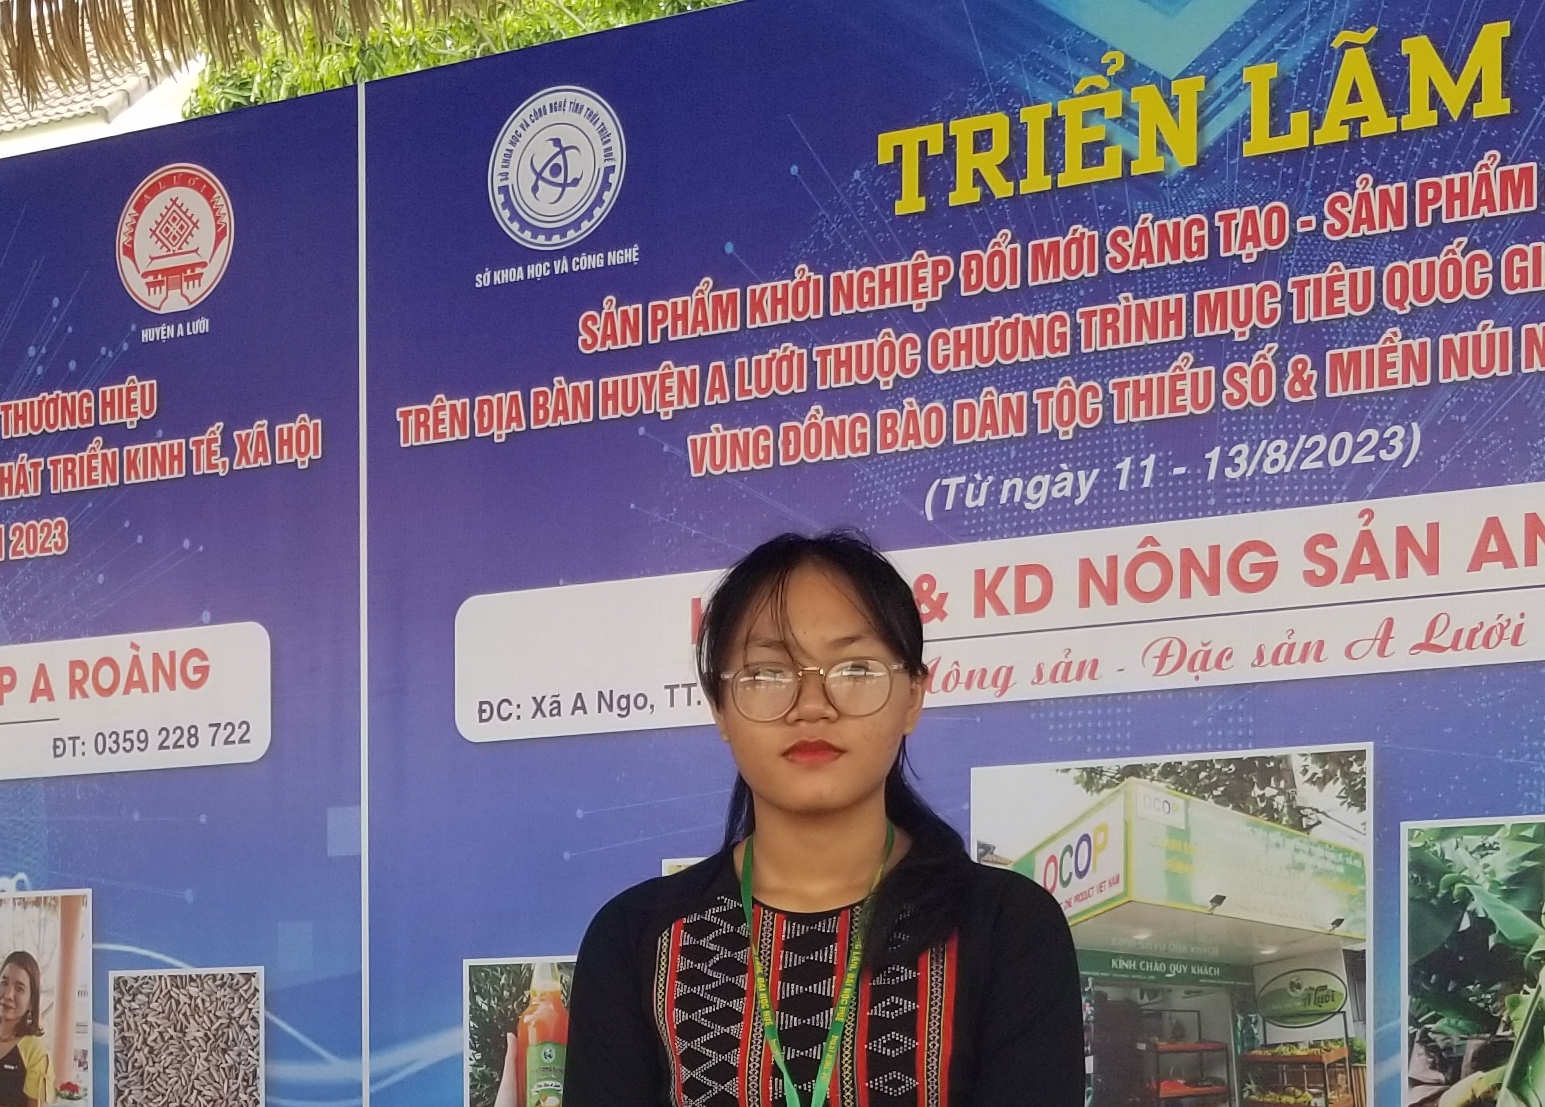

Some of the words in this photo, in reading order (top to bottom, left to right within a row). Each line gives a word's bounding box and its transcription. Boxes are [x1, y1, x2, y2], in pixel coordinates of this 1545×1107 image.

[877, 50, 1206, 216] TRIỂN
[1243, 20, 1511, 157] LÃM
[493, 267, 524, 285] KHOA
[527, 262, 550, 281] HỌC
[553, 255, 568, 274] VÀ
[572, 252, 604, 271] CÔNG
[607, 244, 639, 265] NGHỆ
[578, 295, 642, 353] SẢN
[648, 278, 740, 342] PHẨM
[747, 264, 820, 326] KHỞI
[829, 250, 953, 314] NGHIỆP
[960, 230, 1020, 296] ĐỔI
[1029, 226, 1097, 285] MỚI
[1108, 215, 1207, 272] SÁNG
[1216, 203, 1289, 261] TẠO
[1322, 173, 1408, 240] SẢN
[1415, 150, 1537, 226] PHẨM
[141, 323, 174, 343] HUYỆN
[177, 323, 184, 337] A
[186, 317, 209, 334] LƯỚI
[397, 396, 469, 447] TRÊN
[474, 390, 525, 443] ĐỊA
[530, 377, 593, 430] BÀN
[599, 362, 698, 420] HUYỆN
[705, 360, 729, 404] A
[735, 344, 806, 400] LƯỚI
[815, 330, 921, 390] THUỘC
[930, 312, 1070, 375] CHƯƠNG
[1078, 294, 1185, 353] TRÌNH
[1194, 281, 1282, 341] MỤC
[1290, 265, 1375, 323] TIÊU
[1383, 238, 1493, 312] QUỐC
[688, 423, 773, 476] VÙNG
[779, 405, 870, 465] ĐỒNG
[878, 404, 946, 454] BÀO
[952, 390, 1027, 445] DÂN
[1036, 378, 1103, 441] TỘC
[1110, 356, 1214, 423] THIỂU
[1222, 345, 1275, 407] SỐ
[1285, 357, 1317, 400] &
[1326, 328, 1431, 397] MIỀN
[1439, 320, 1512, 383] NÚI
[924, 468, 995, 520] (Từ
[1001, 464, 1101, 512] ngày
[1115, 453, 1155, 491] 11
[1204, 423, 1422, 482] 13/8/2023)
[9, 516, 68, 559] 2023
[913, 573, 949, 624] &
[974, 564, 1054, 618] KD
[1079, 537, 1279, 609] NÔNG
[1302, 508, 1441, 587] SẢN
[29, 664, 54, 703] A
[69, 641, 210, 700] ROÀNG
[1031, 649, 1101, 688] sản
[1142, 636, 1234, 687] Đặc
[1251, 630, 1327, 672] sản
[1343, 619, 1394, 662] A
[1409, 612, 1527, 655] Lưới
[477, 700, 521, 723] ĐC:
[531, 693, 562, 719] Xã
[570, 692, 588, 716] A
[597, 690, 654, 717] Ngo,
[665, 683, 701, 709] TT.
[53, 736, 87, 759] ĐT:
[94, 727, 149, 757] 0359
[157, 724, 200, 752] 228
[208, 720, 251, 748] 722
[1043, 822, 1108, 894] OCOP
[1108, 873, 1119, 888] NAM
